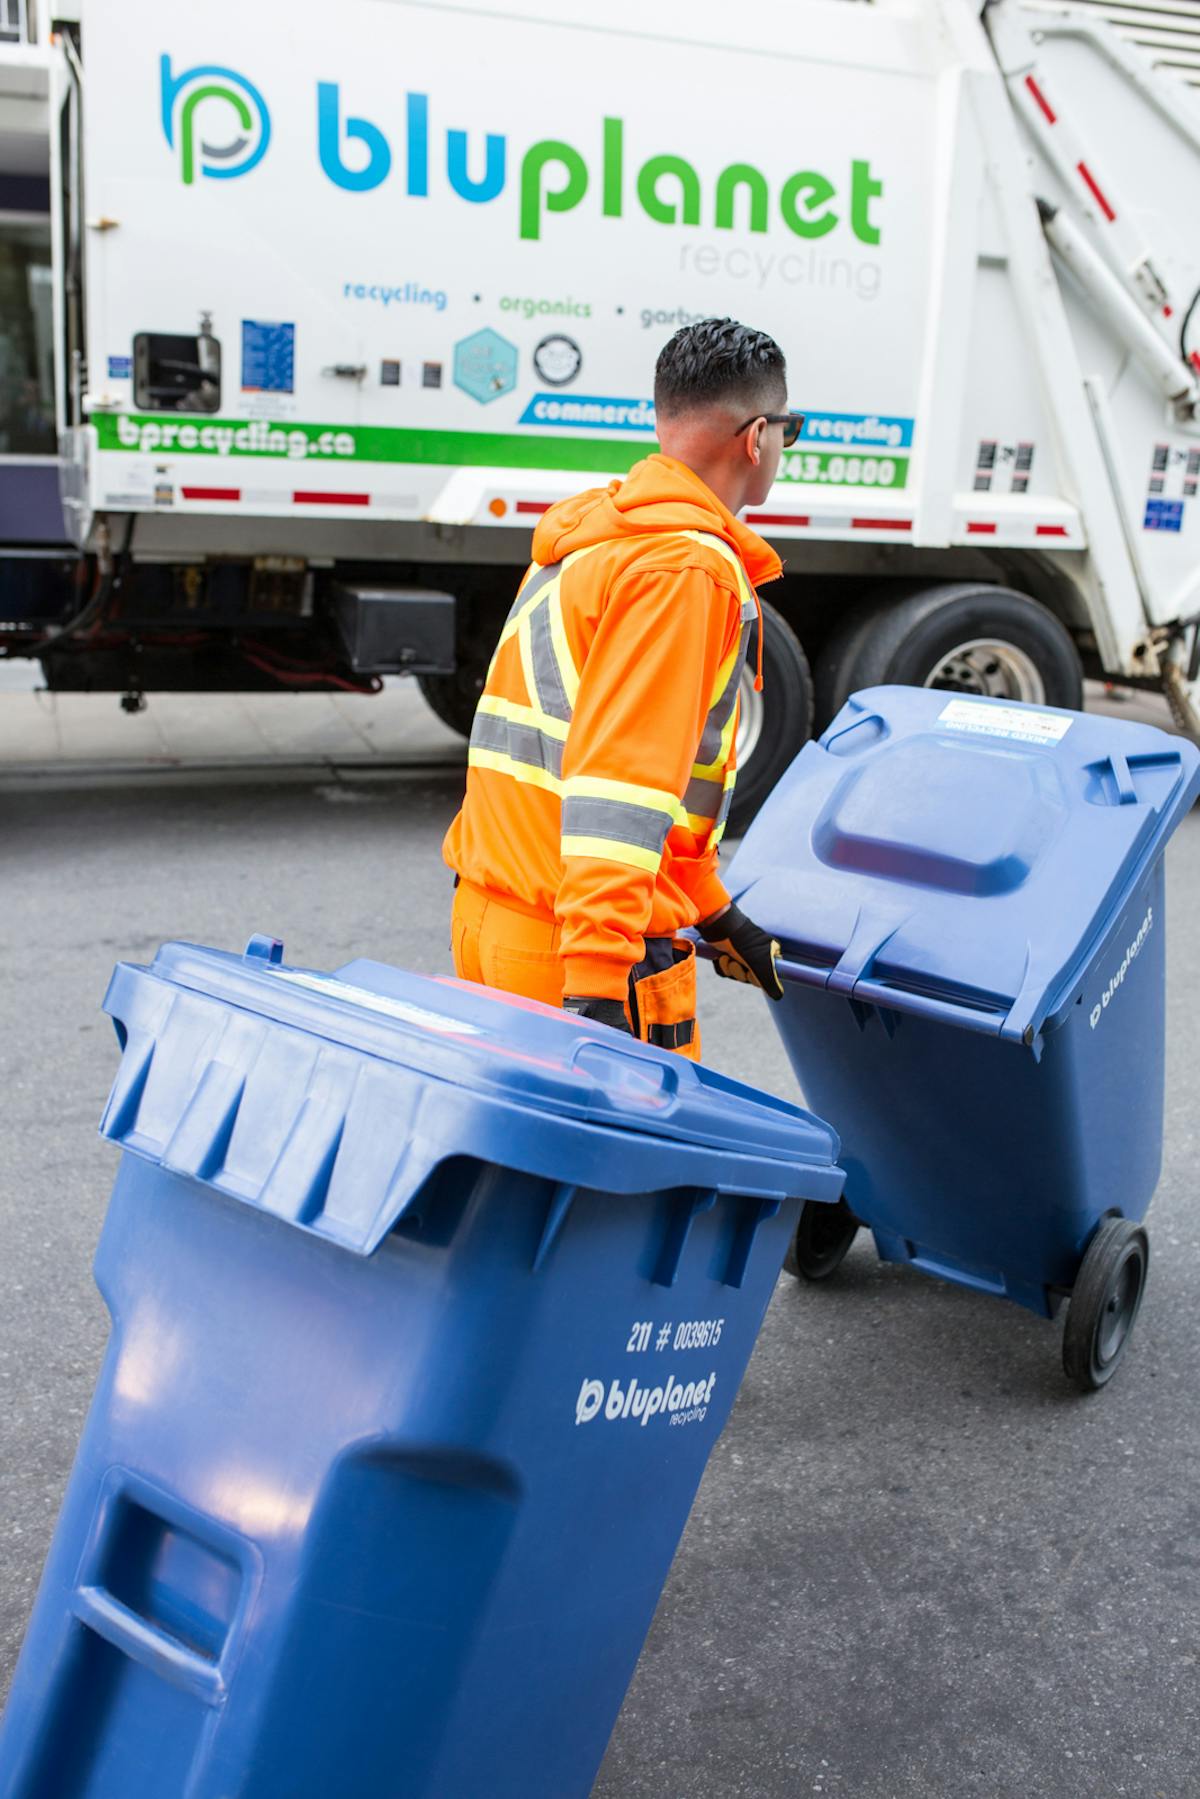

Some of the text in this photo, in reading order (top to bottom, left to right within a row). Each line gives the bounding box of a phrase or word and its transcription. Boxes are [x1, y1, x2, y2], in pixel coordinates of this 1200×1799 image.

[317, 81, 883, 245] bluplanet
[680, 242, 883, 301] recycling
[343, 281, 448, 312] recycling
[500, 294, 593, 320] organics
[116, 415, 356, 460] bprecycling.ca
[533, 401, 903, 447] commercia recycling
[1102, 907, 1153, 1008] bluplanet
[626, 1321, 653, 1352] 211
[655, 1322, 672, 1352] #
[604, 1371, 717, 1427] bluplanet
[669, 1406, 707, 1426] recycling
